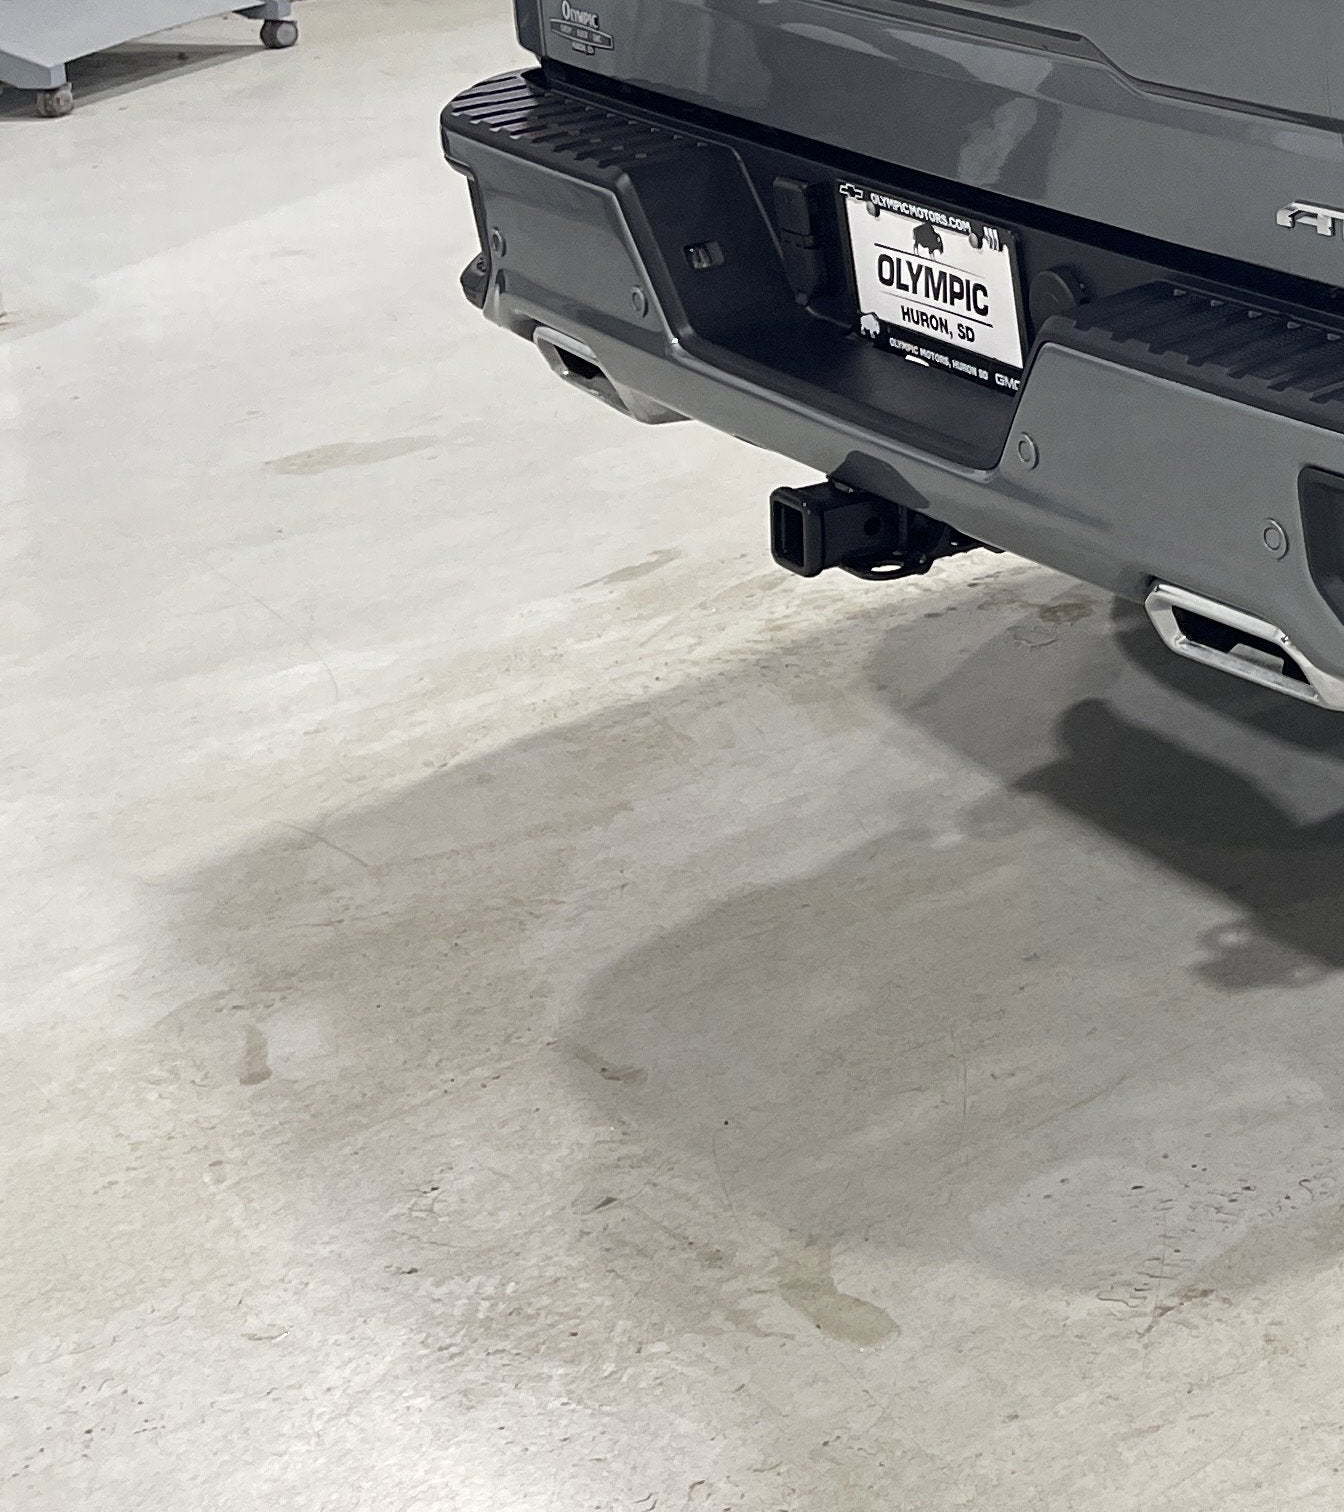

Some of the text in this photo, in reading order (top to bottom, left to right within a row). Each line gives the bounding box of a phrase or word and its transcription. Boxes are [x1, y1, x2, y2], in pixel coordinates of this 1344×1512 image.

[877, 253, 990, 317] OLYMPIC
[900, 305, 976, 343] HURON, SD
[994, 372, 1021, 391] GMC
